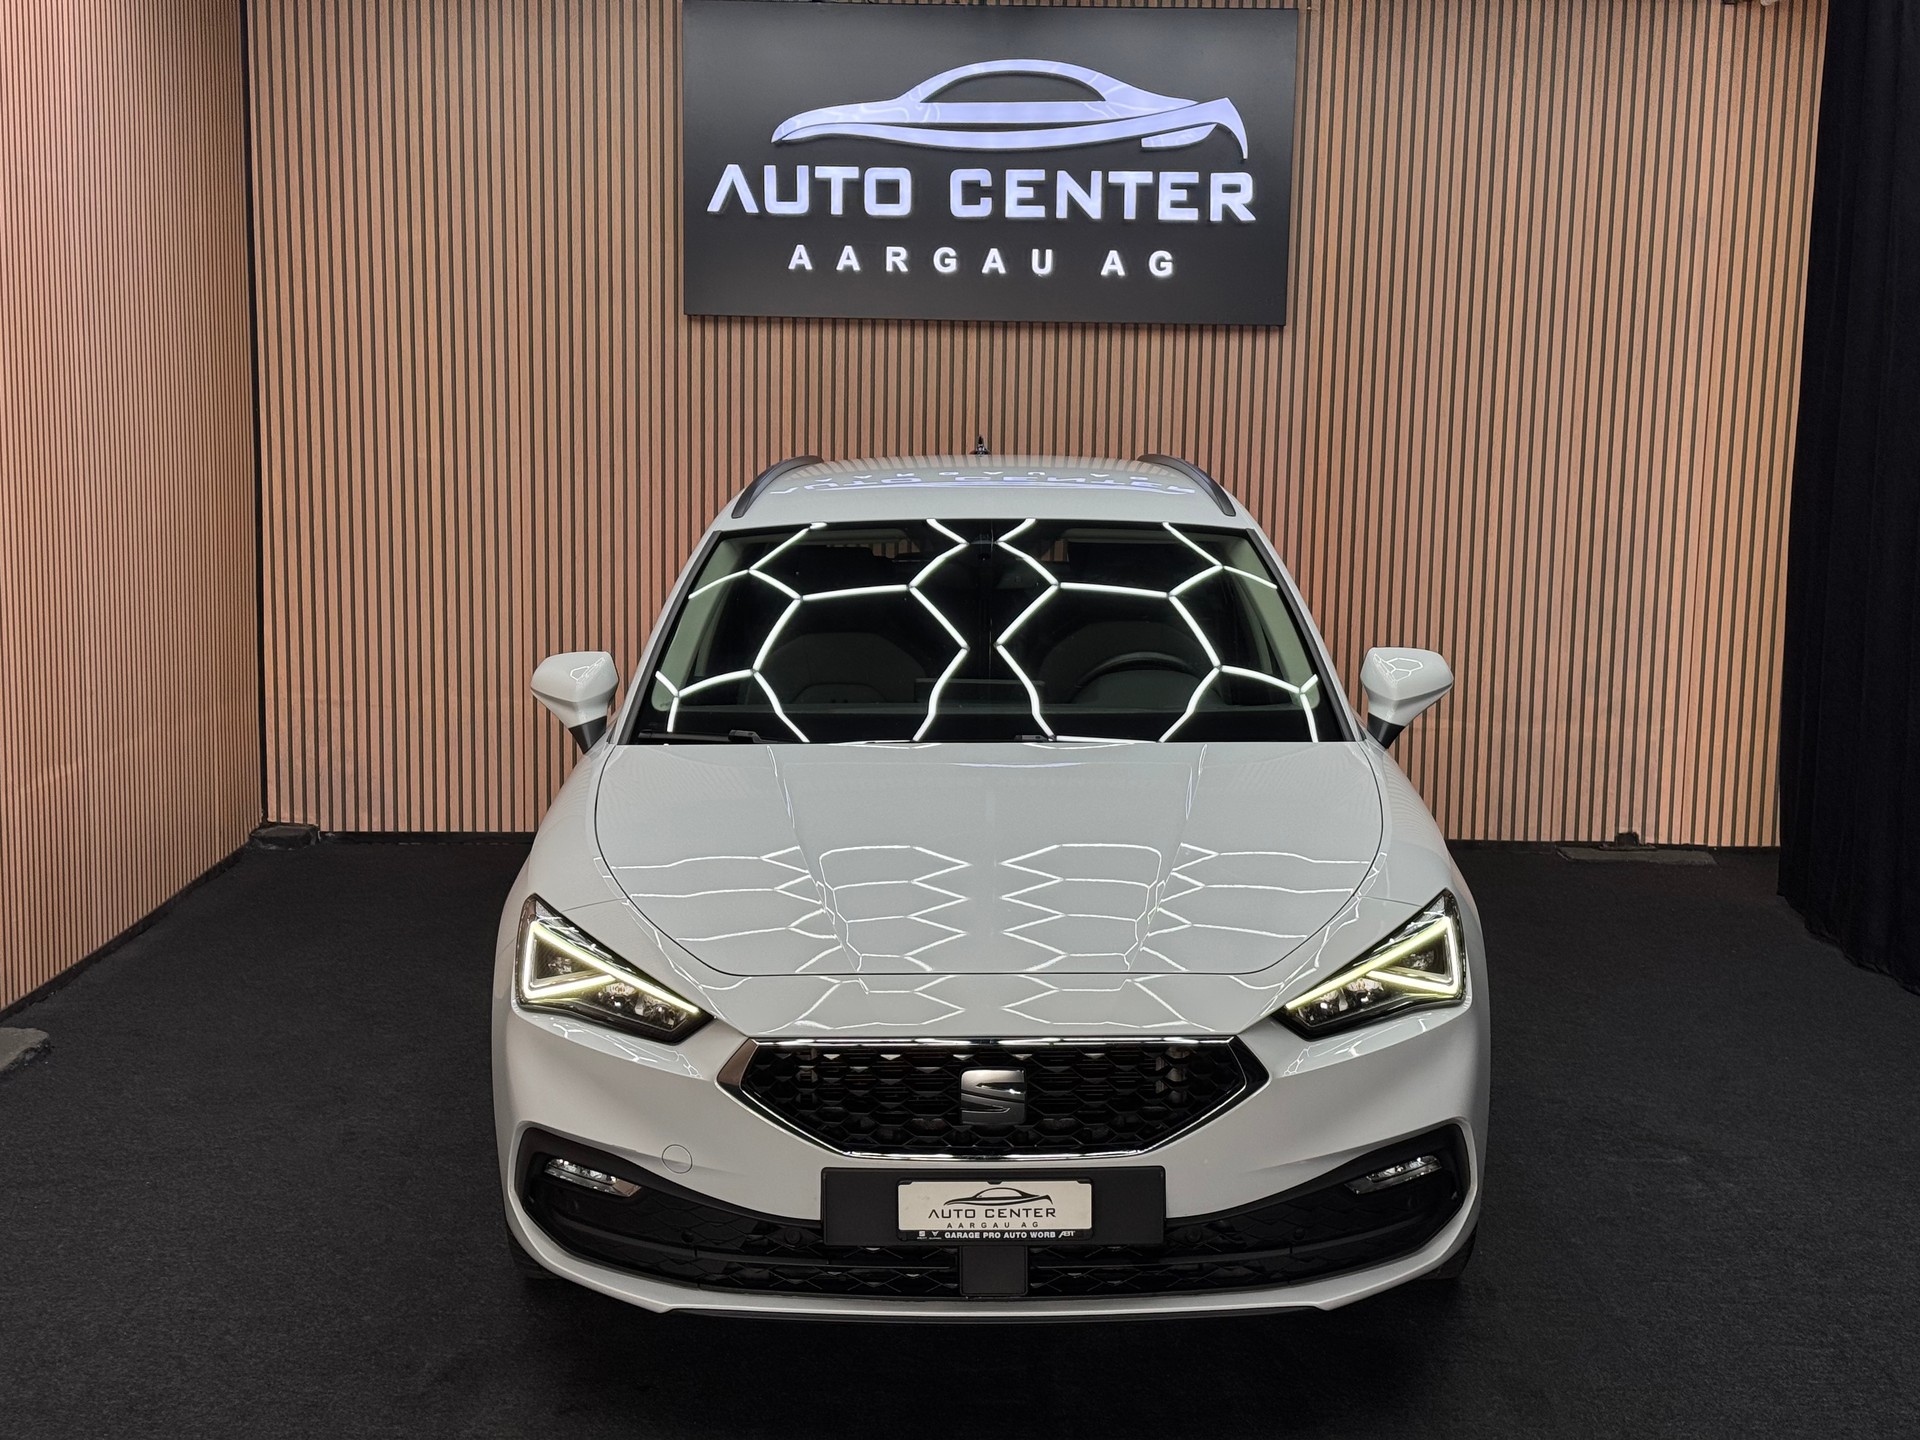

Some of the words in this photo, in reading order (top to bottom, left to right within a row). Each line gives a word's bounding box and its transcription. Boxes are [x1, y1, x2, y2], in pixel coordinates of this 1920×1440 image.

[706, 163, 913, 217] AUTO
[949, 168, 1257, 222] CENTER
[788, 244, 1054, 277] AARGAU
[1100, 249, 1174, 278] AG
[928, 1208, 976, 1219] AUTO
[984, 1207, 1057, 1218] CENTER
[946, 1221, 1010, 1229] AARGAU
[944, 1231, 981, 1239] GARAGE
[982, 1231, 1001, 1239] PRO
[1003, 1231, 1028, 1239] AUTO
[1029, 1231, 1057, 1239] WORB
[1058, 1230, 1076, 1239] ABT
